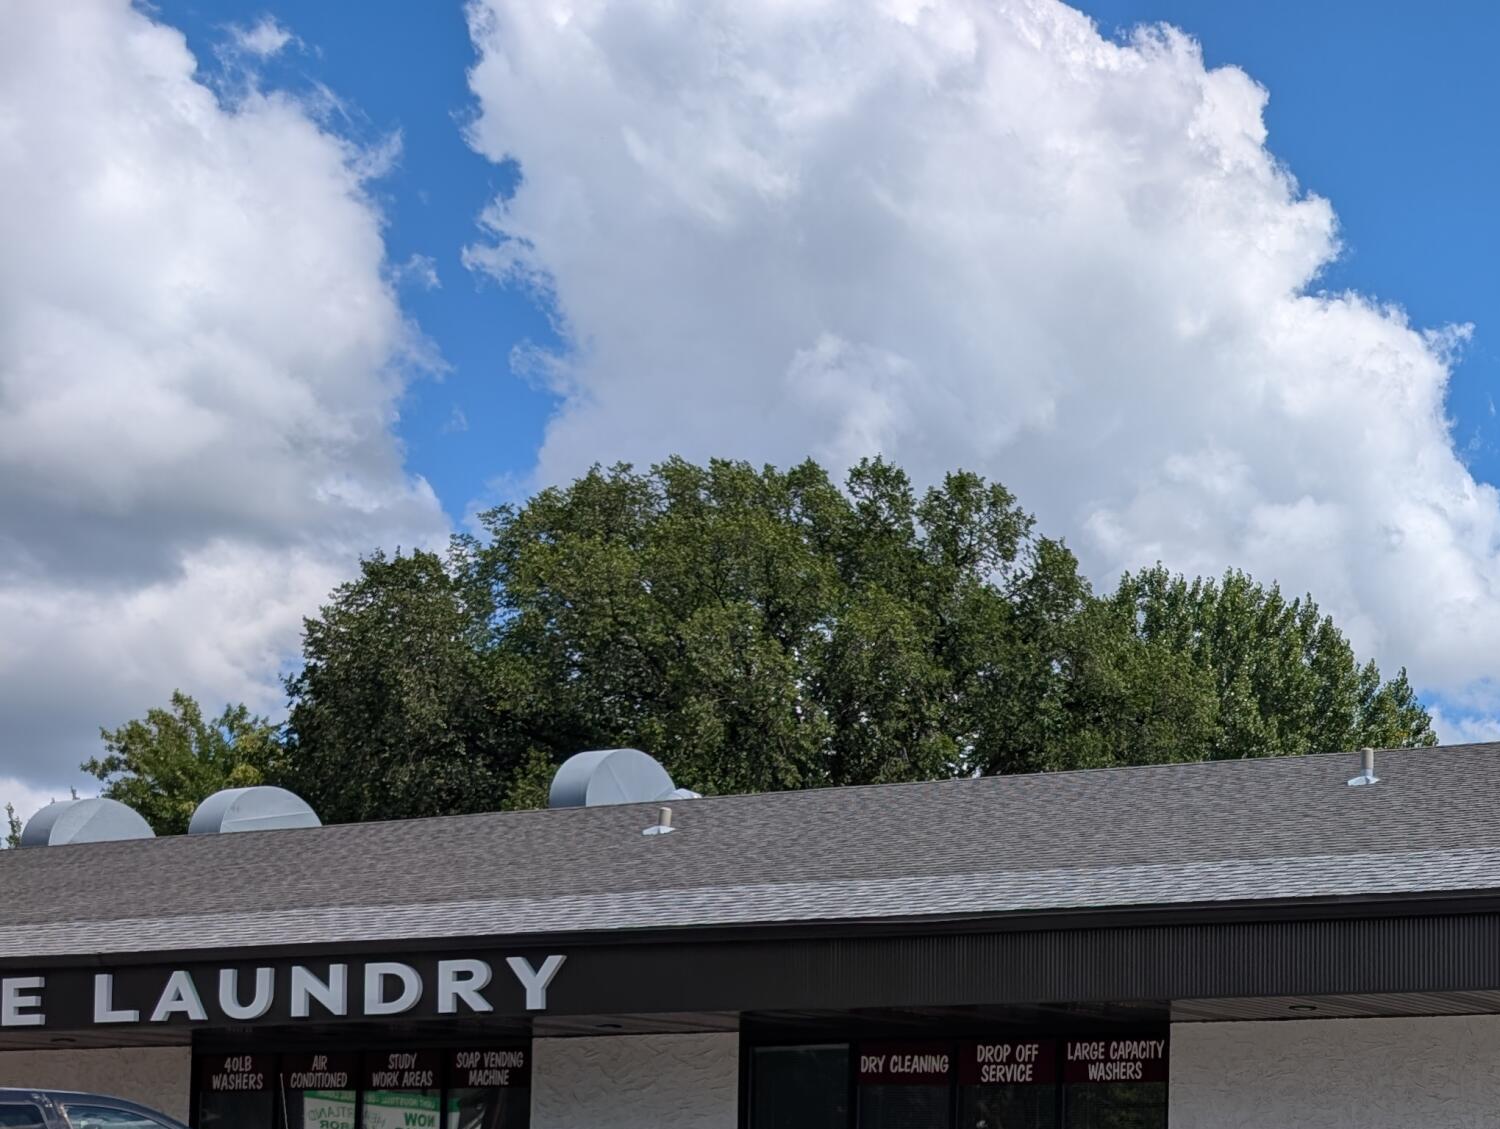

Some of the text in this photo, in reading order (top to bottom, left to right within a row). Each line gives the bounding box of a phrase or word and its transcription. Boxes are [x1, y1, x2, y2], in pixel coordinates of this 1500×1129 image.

[93, 955, 567, 1023] LAUNDRY
[456, 1051, 524, 1068] SOAP VENDING
[976, 1044, 1039, 1063] DROP OFF
[1067, 1040, 1165, 1061] LARGE CAPACITY
[224, 1055, 252, 1073] 40LB
[312, 1055, 328, 1071] AIR
[388, 1053, 417, 1070] STUDY
[860, 1054, 949, 1074] DRY CLEANING
[290, 1072, 348, 1088] CONDITIONED
[372, 1070, 433, 1087] WORK AREAS
[468, 1069, 510, 1086] MACHINE
[980, 1064, 1034, 1083] SERVICE
[1087, 1062, 1143, 1081] WASHERS
[212, 1073, 264, 1091] WASHERS
